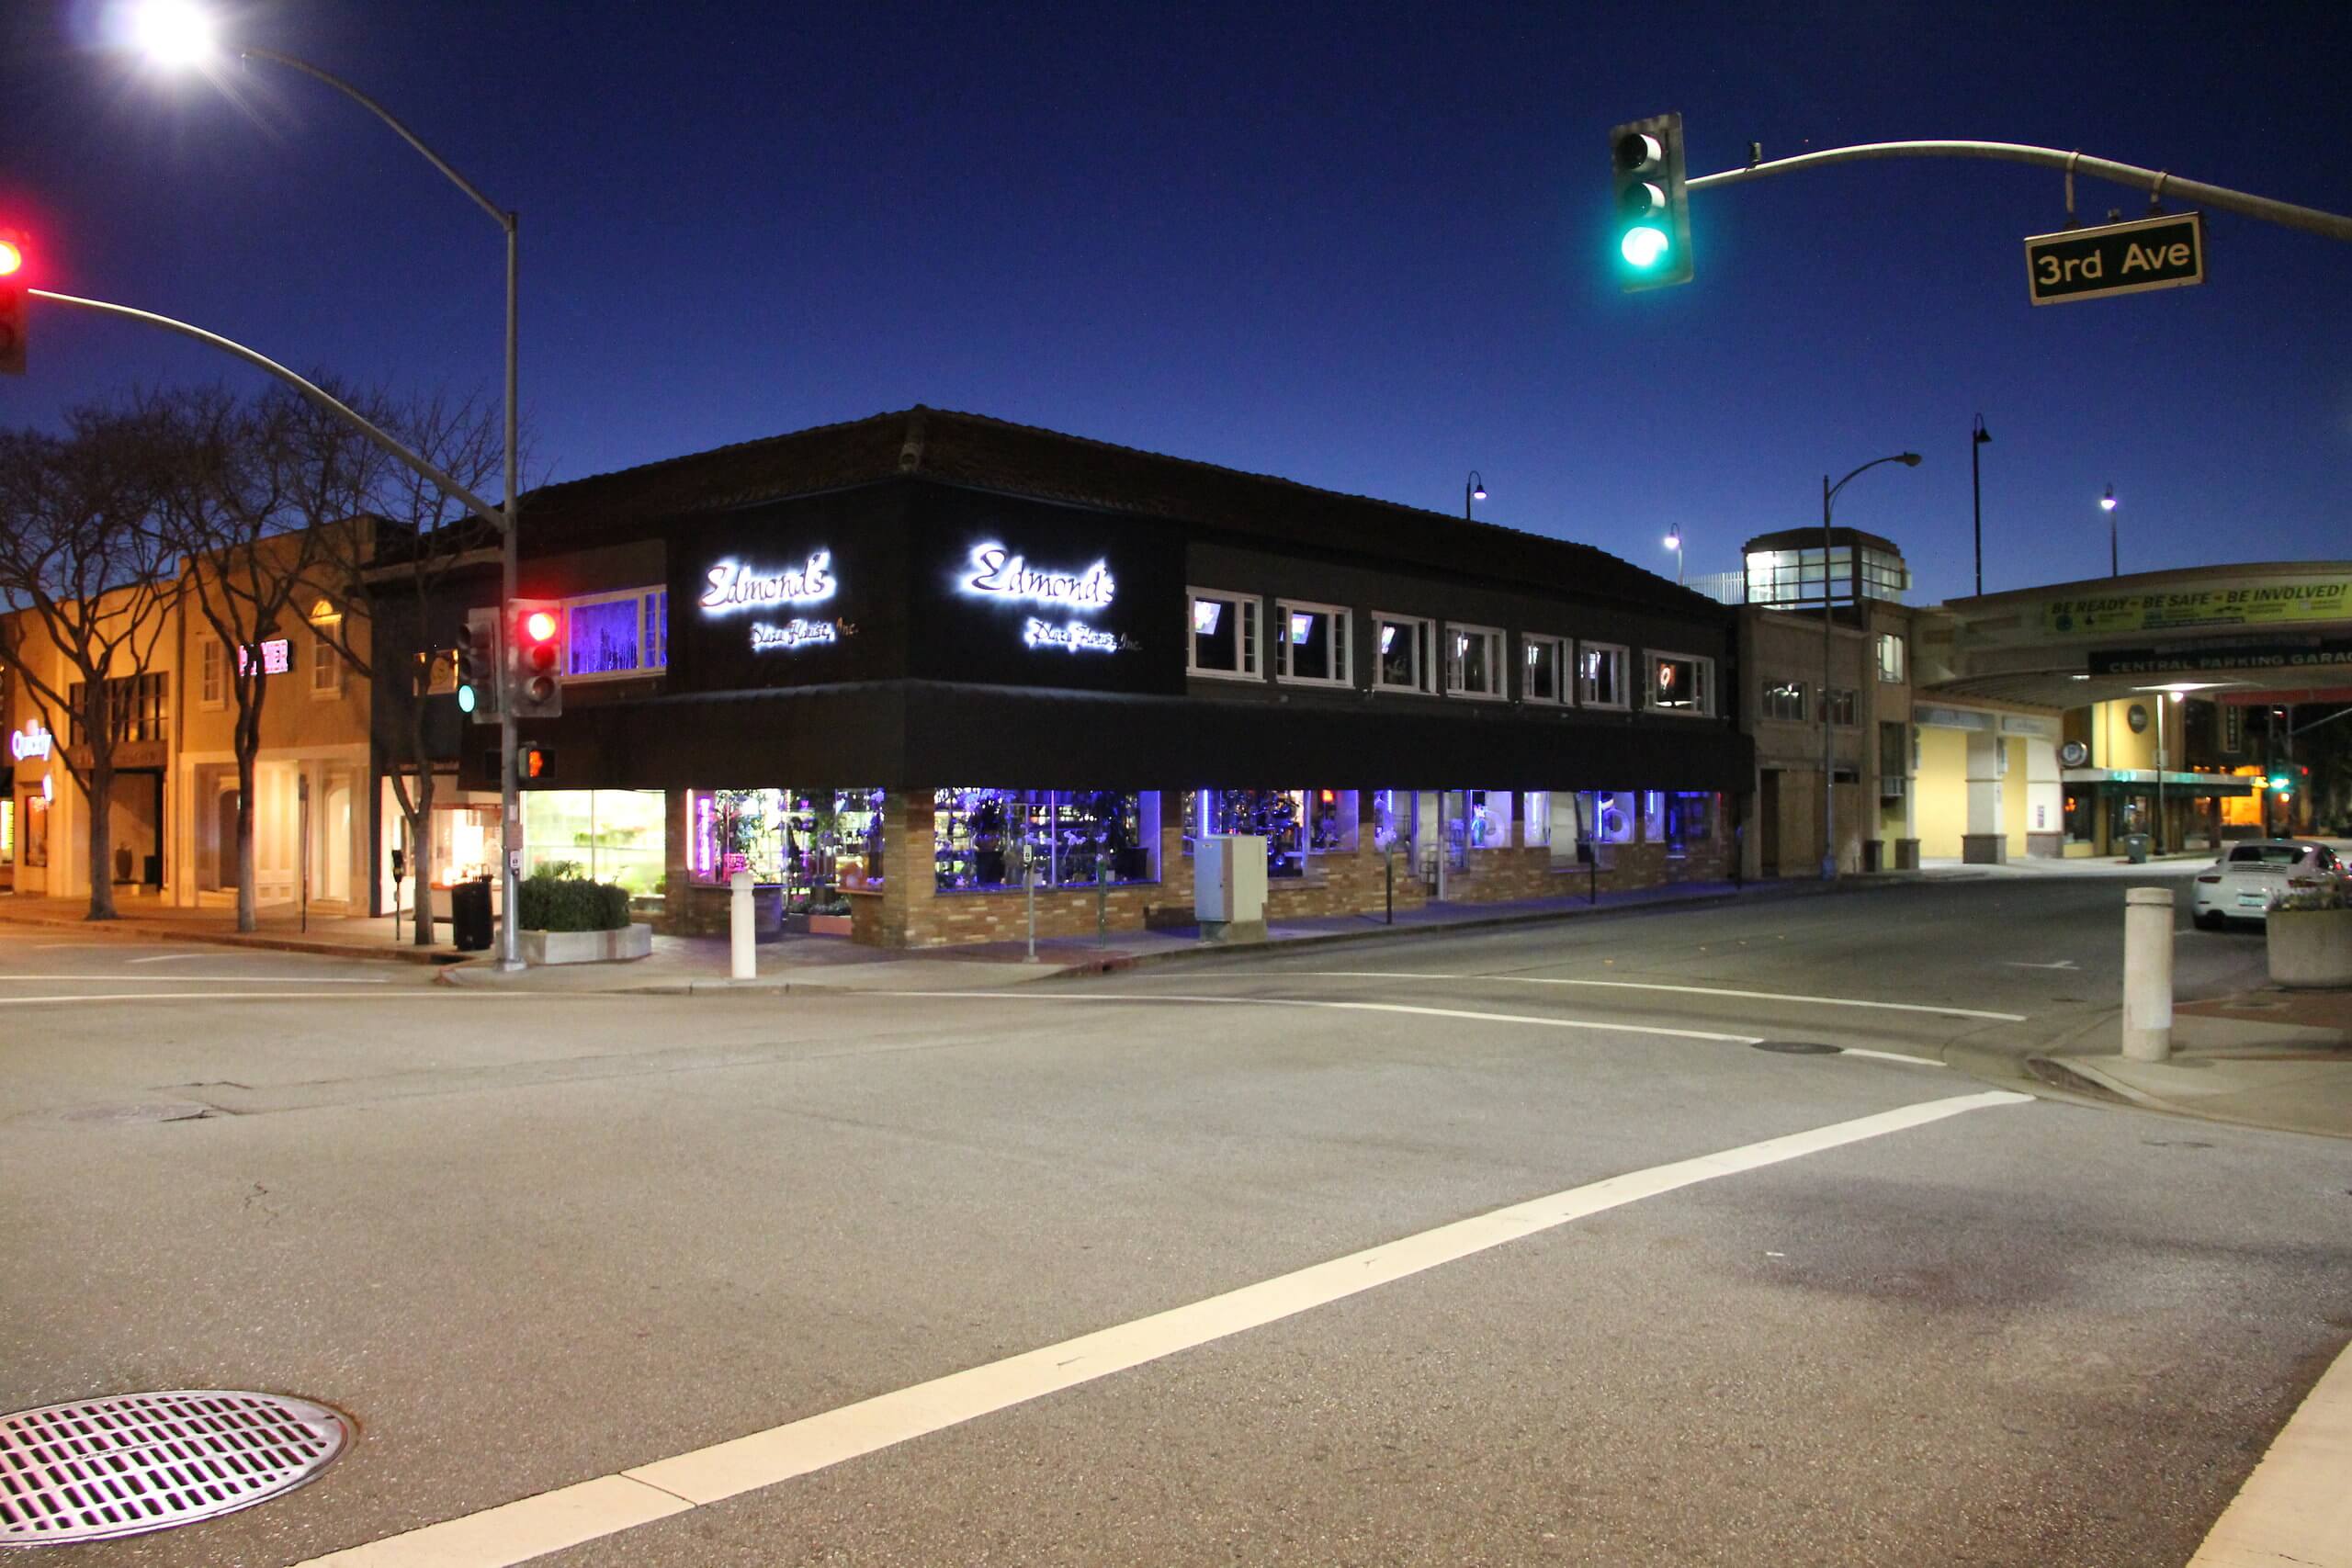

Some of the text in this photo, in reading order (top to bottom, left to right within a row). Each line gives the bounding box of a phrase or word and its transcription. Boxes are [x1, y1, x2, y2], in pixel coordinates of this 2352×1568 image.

[2038, 242, 2190, 285] 3rd Ave
[968, 548, 1115, 604] Edmond's
[2052, 584, 2347, 615] BE READY BE SAFE BE INVOLVED!
[2109, 660, 2193, 673] CENTRAL
[2200, 655, 2286, 669] PARKING
